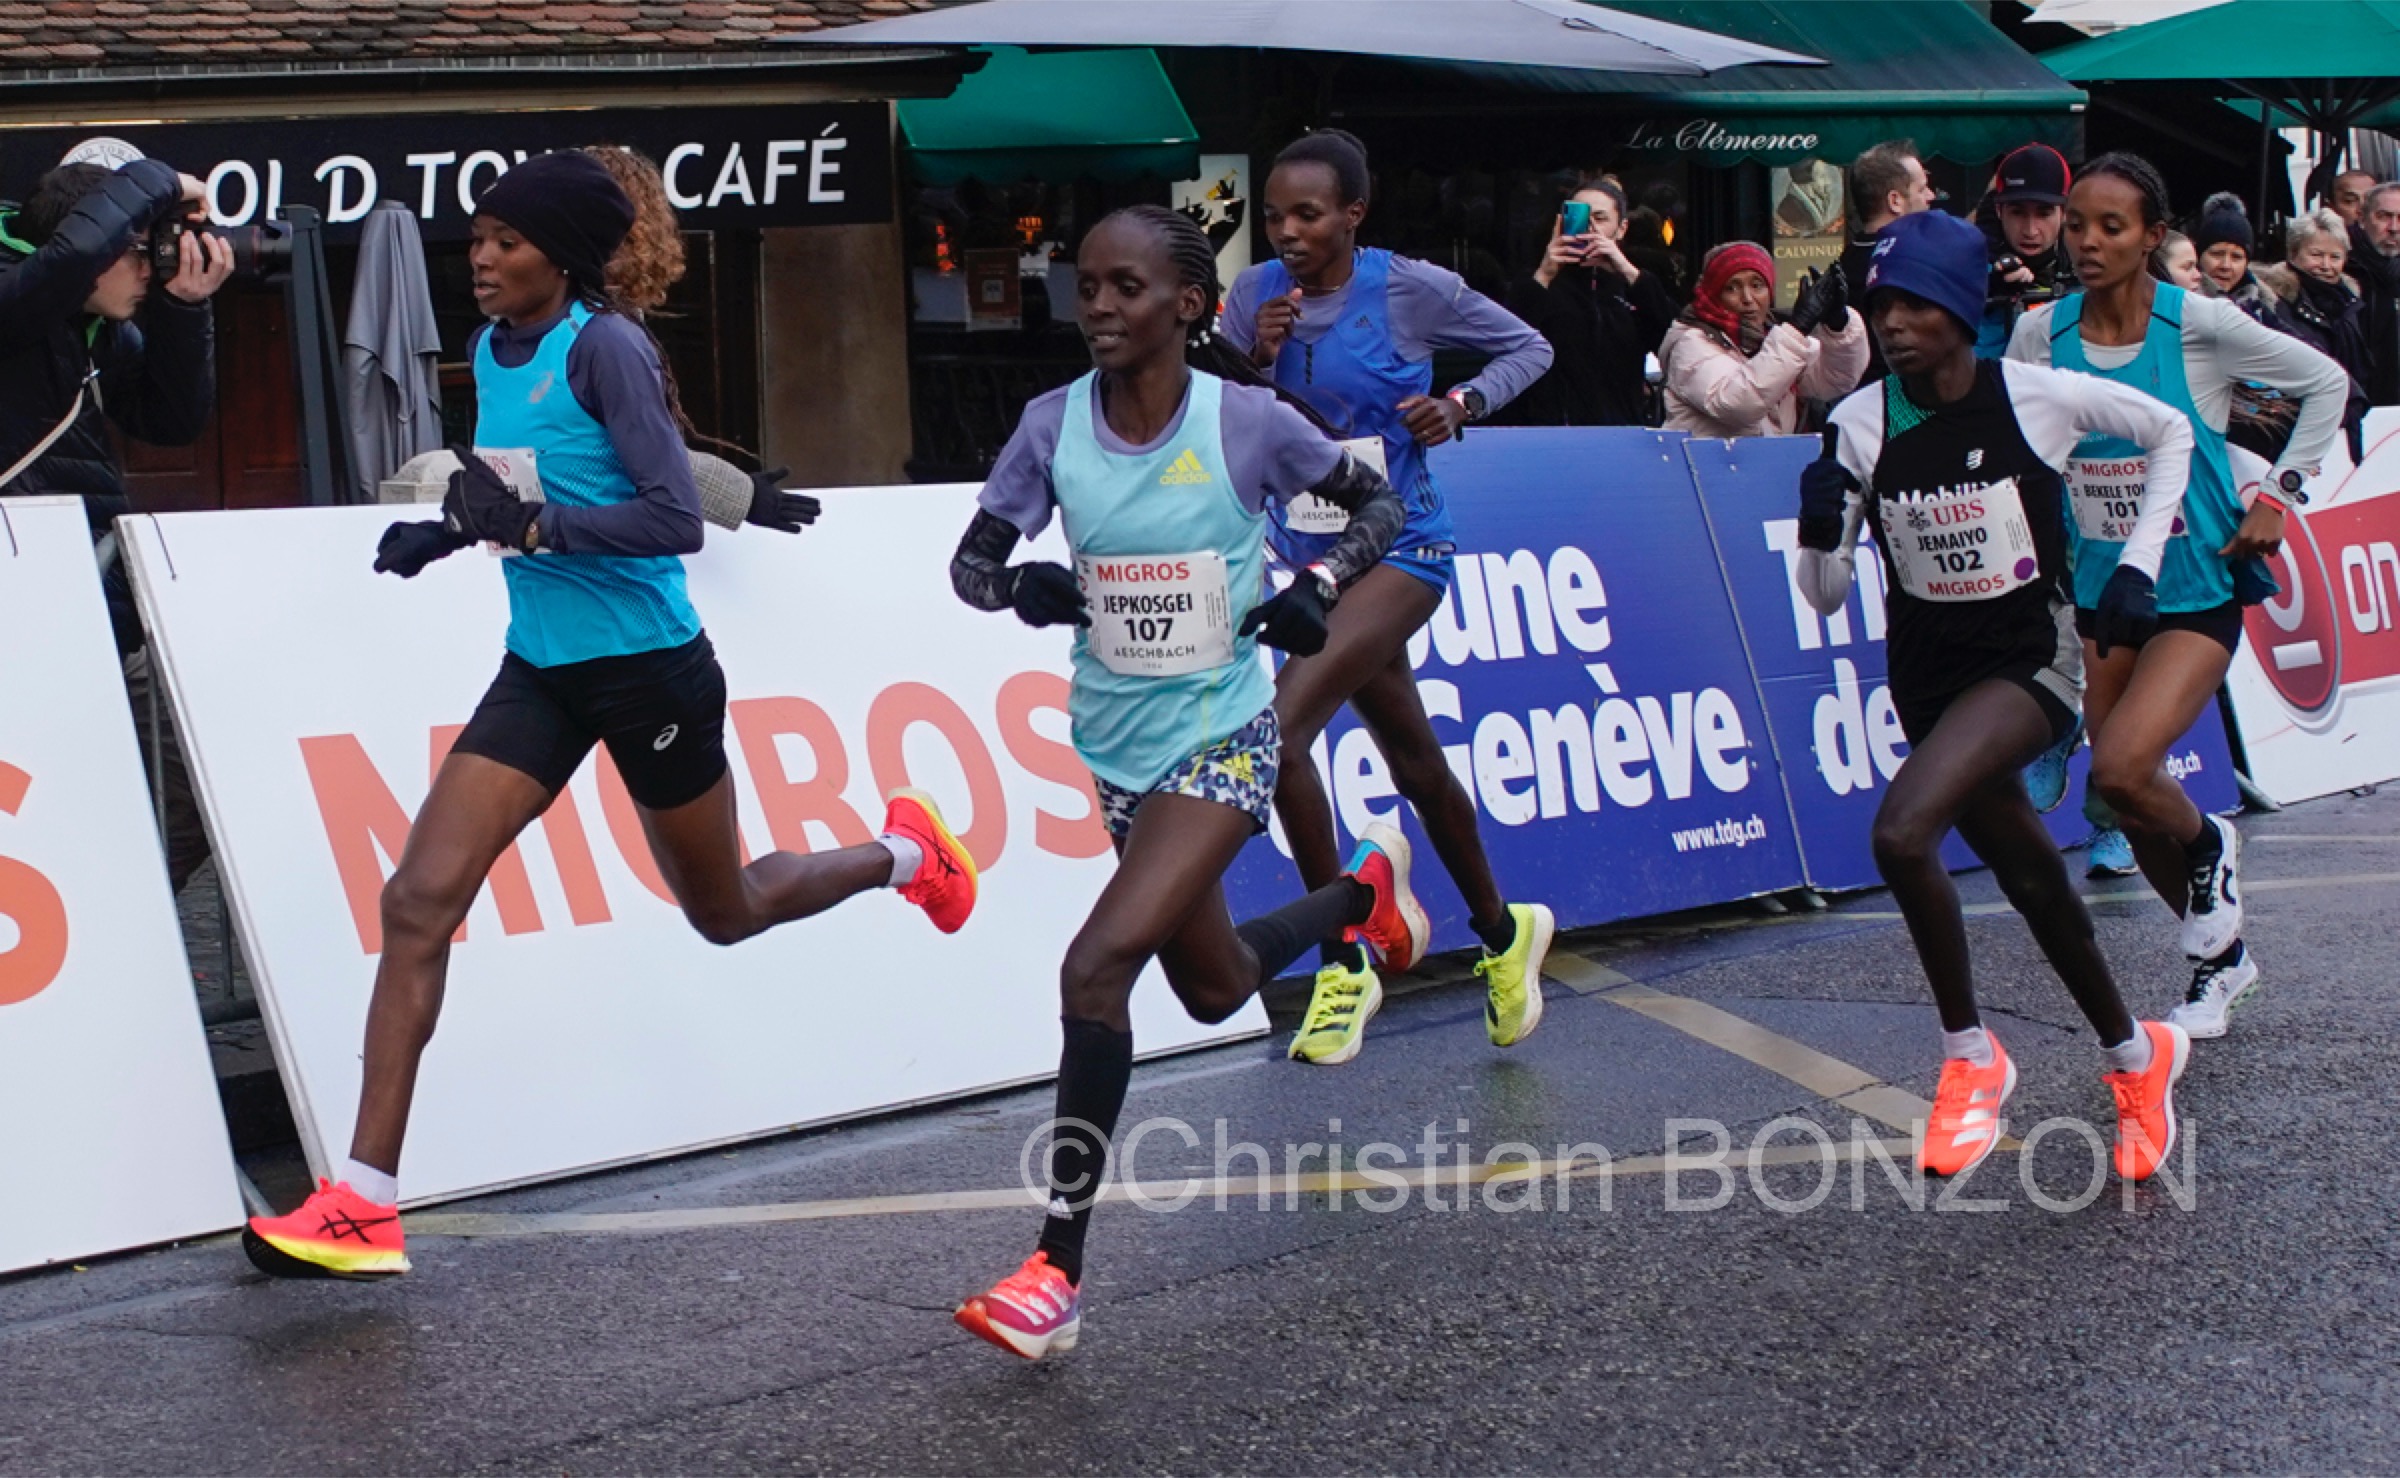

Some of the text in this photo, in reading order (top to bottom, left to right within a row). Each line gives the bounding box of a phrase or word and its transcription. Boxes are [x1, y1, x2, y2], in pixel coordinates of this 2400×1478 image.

[1625, 118, 1819, 150] La Clémence
[663, 121, 848, 209] CAFÉ
[1159, 470, 1212, 486] adidas
[2081, 461, 2147, 478] MIGROS
[2083, 484, 2122, 499] BEKELE
[1932, 499, 1987, 527] UBS
[2103, 501, 2139, 519] 101
[1917, 526, 1988, 551] JEMAIYO
[1096, 561, 1191, 583] MIGROS
[1933, 550, 1985, 574] 102
[1927, 573, 2006, 596] MIGROS
[1103, 591, 1193, 615] JEPKOSGEI
[1124, 617, 1174, 642] 107
[1113, 644, 1196, 660] AESCHBACH
[2166, 749, 2203, 780] dg.ch
[1672, 814, 1767, 853] www.tdg.ch
